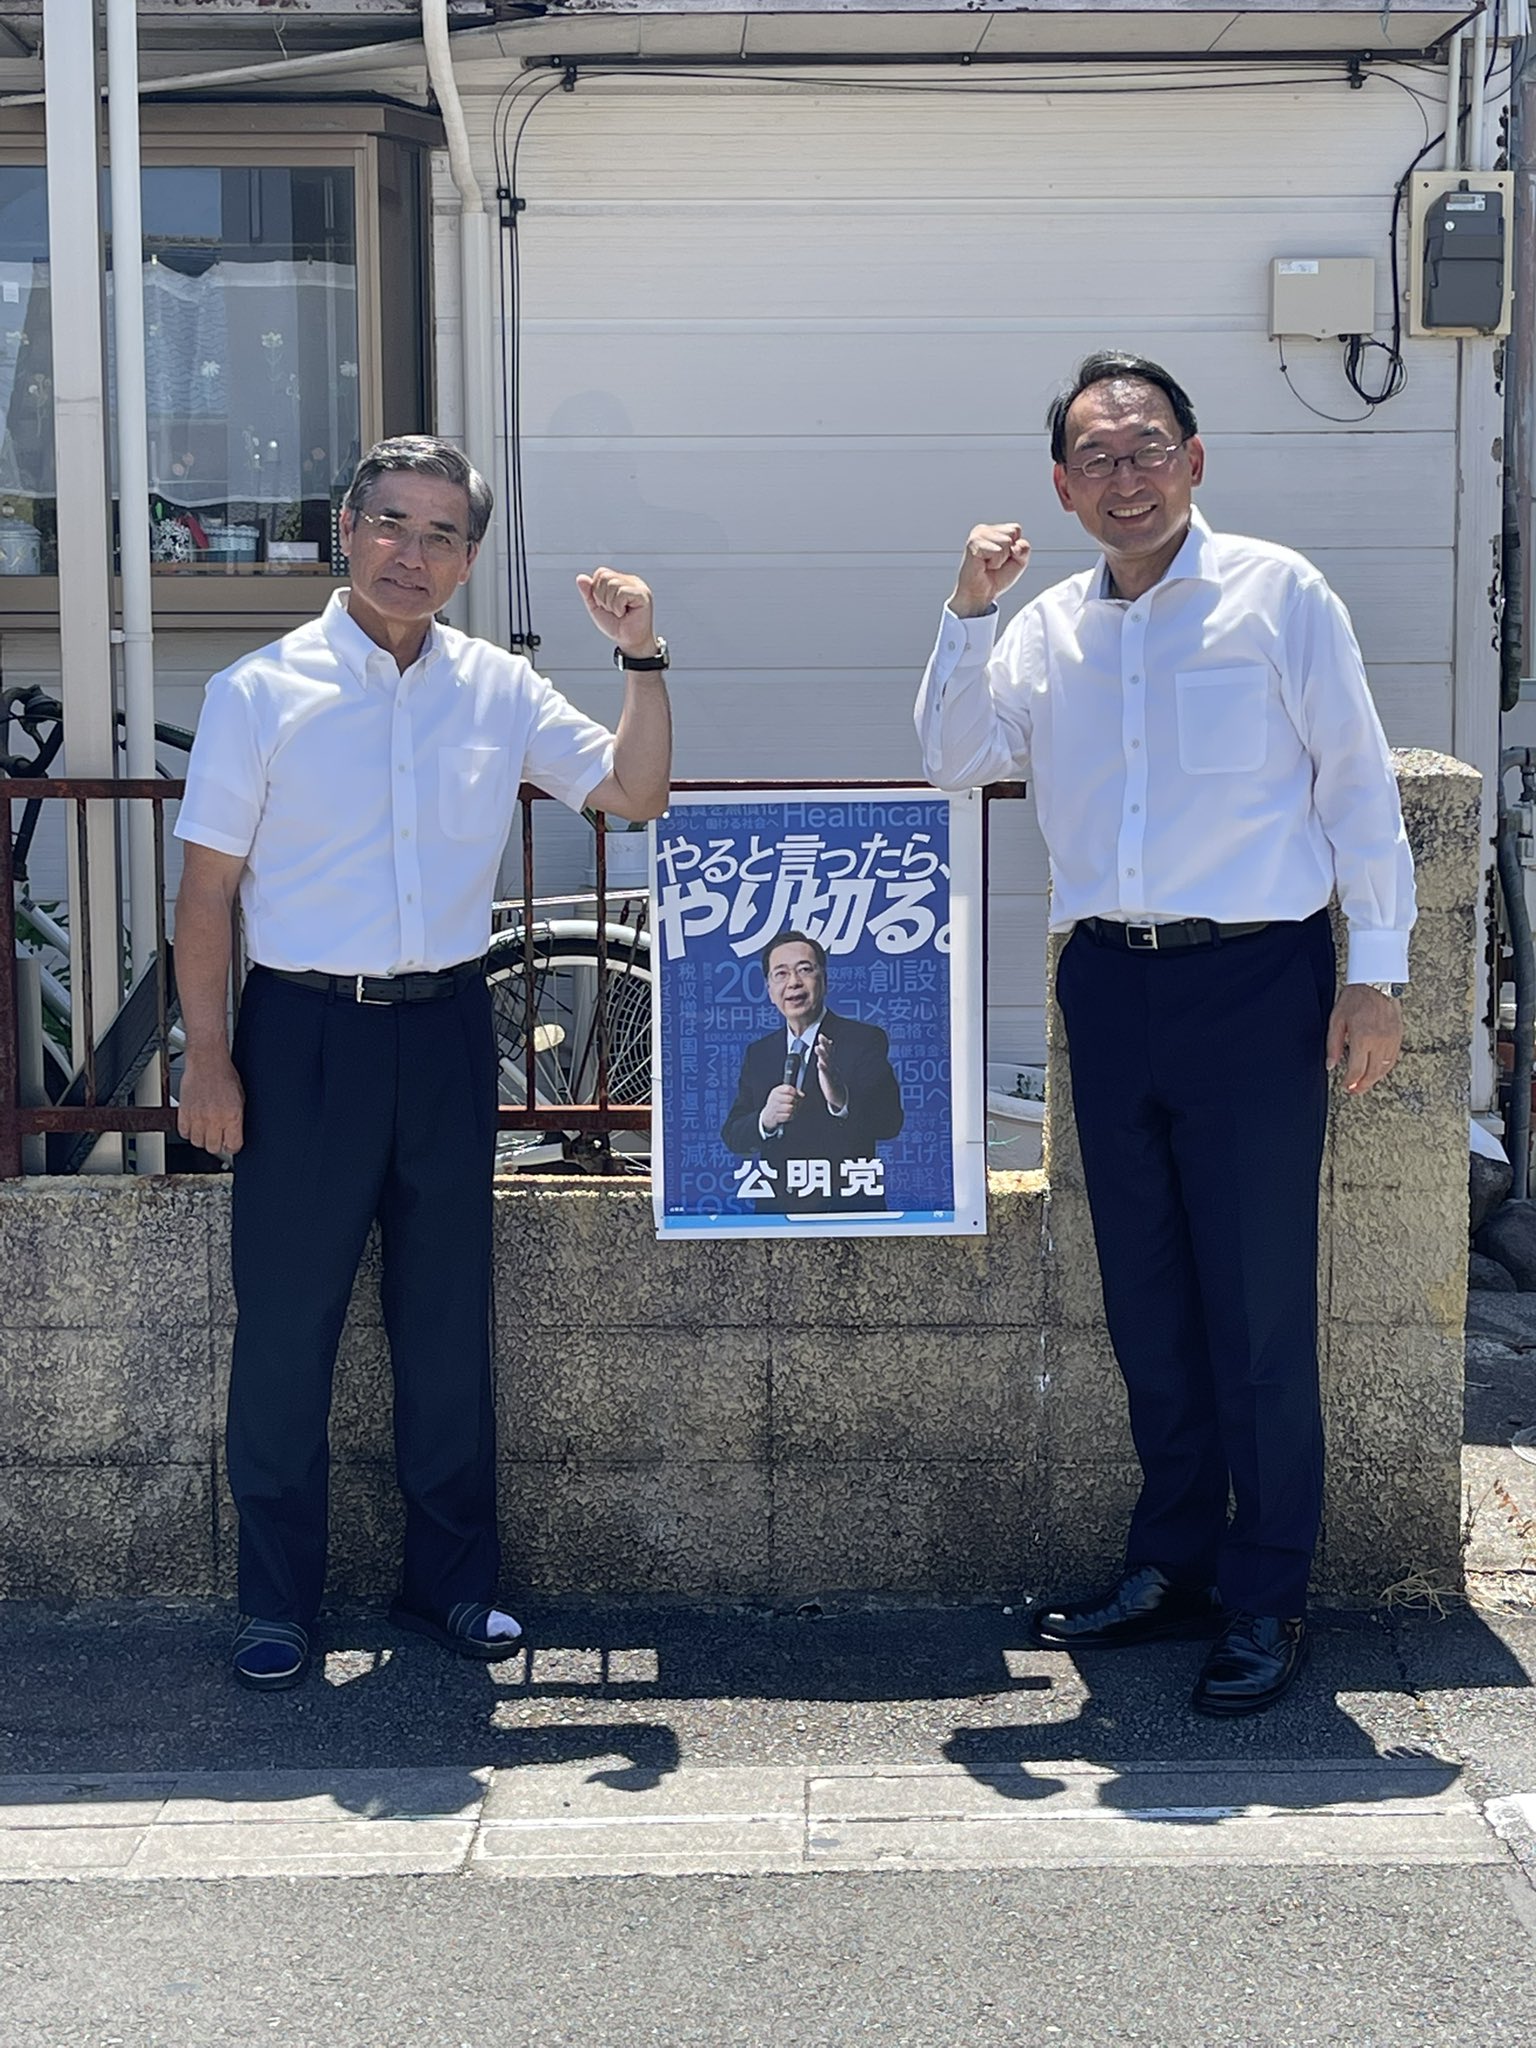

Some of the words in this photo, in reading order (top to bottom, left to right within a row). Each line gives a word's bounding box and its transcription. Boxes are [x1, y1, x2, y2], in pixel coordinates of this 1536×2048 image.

[783, 802, 950, 828] Healthcare
[868, 959, 937, 994] 創設
[733, 1157, 885, 1198] 公明党
